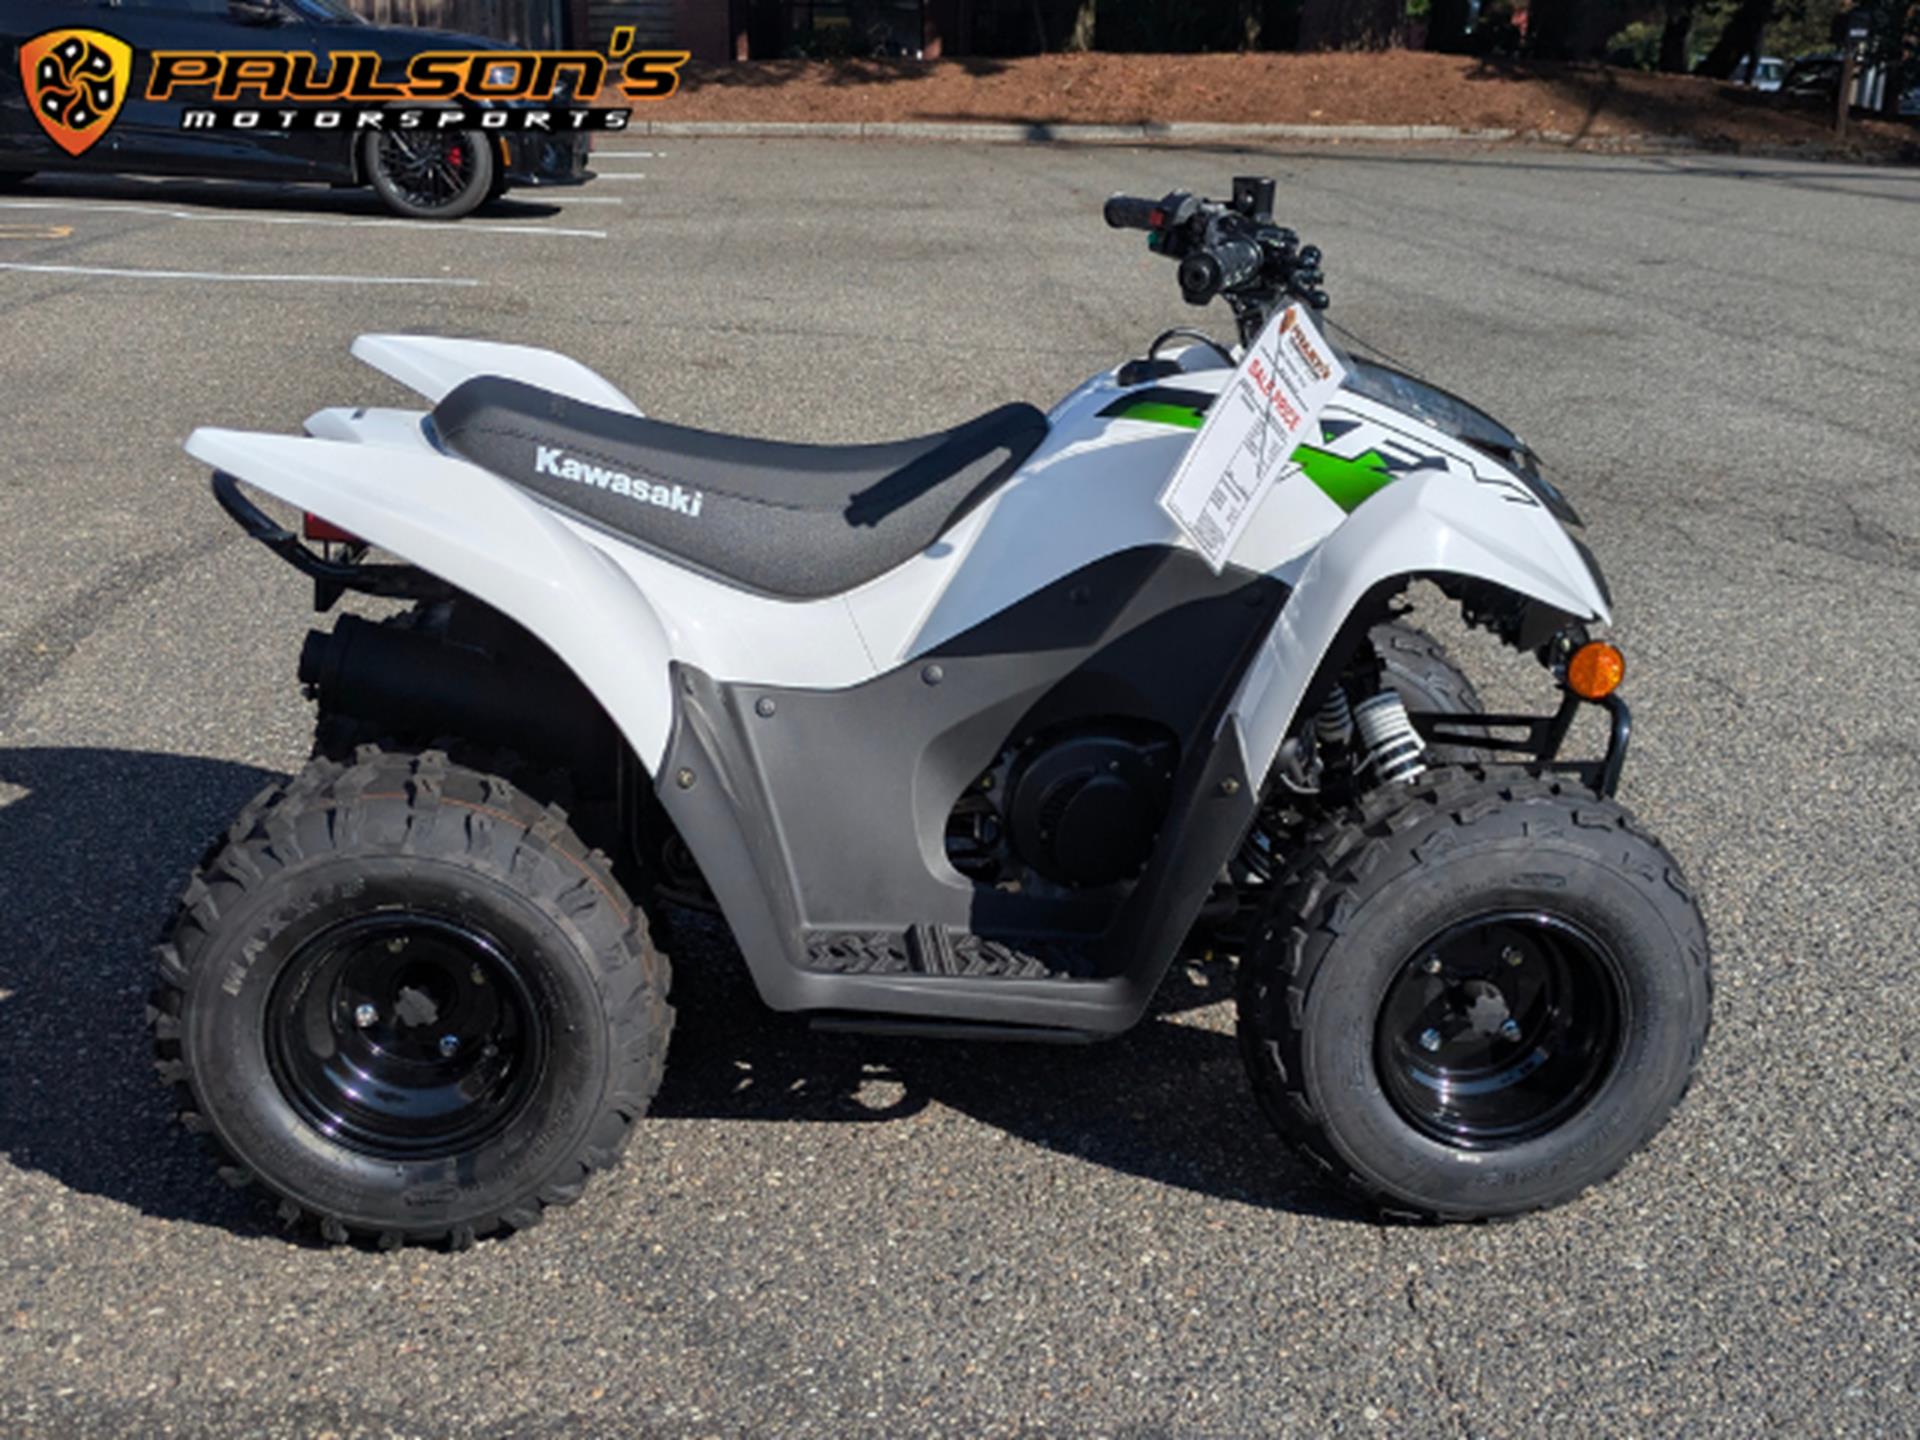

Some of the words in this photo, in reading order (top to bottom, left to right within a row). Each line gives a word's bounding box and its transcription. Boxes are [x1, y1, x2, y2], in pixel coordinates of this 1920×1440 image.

[1247, 356, 1276, 398] SALE
[1270, 389, 1302, 432] PRICE
[535, 446, 703, 517] Kawasaki
